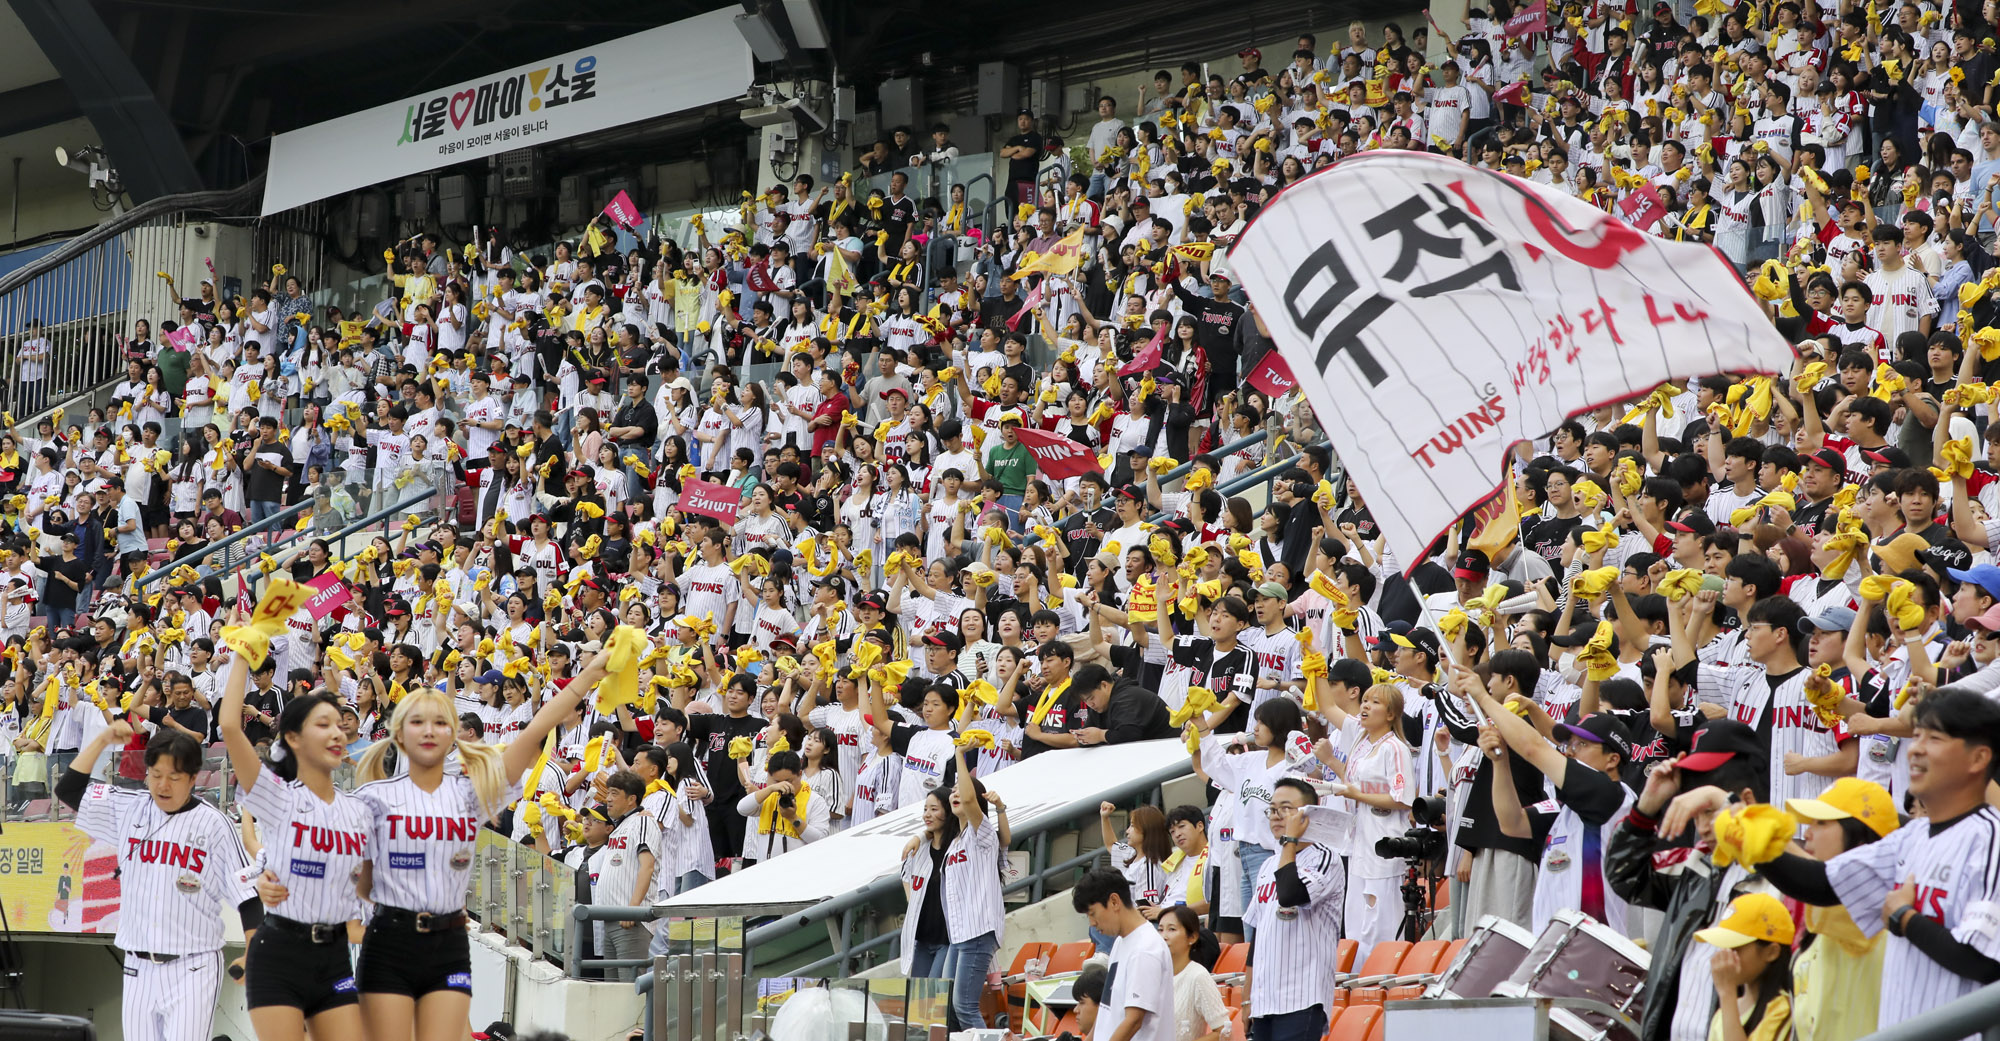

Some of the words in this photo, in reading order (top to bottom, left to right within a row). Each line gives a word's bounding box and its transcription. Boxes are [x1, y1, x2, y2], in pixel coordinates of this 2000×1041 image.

[397, 97, 448, 146] 서울
[438, 141, 465, 155] 마음이
[466, 135, 492, 149] 모이면
[494, 127, 520, 142] 서울이
[522, 119, 548, 136] 됩니다
[1283, 182, 1521, 387] 무적
[1871, 293, 1917, 306] WINS
[1202, 311, 1233, 326] TWINS
[890, 328, 914, 337] TWINS
[1480, 382, 1496, 402] LG
[983, 419, 1000, 429] SEO
[885, 434, 905, 444] WINS
[1412, 397, 1506, 469] TWINS
[379, 441, 401, 454] TWINS
[994, 458, 1019, 467] merry
[691, 582, 724, 594] TWINS
[238, 640, 259, 661] TWINS
[1274, 646, 1285, 654] LG
[1052, 704, 1062, 712] LG
[1545, 701, 1572, 720] TWIN
[1734, 702, 1801, 728] TWIN
[386, 816, 478, 842] TWINS
[186, 832, 205, 847] LG
[17, 847, 43, 875] 일원
[128, 838, 207, 873] TWINS
[391, 856, 424, 868] 신한카드
[292, 862, 324, 877] 신한카드
[1930, 865, 1950, 880] LG
